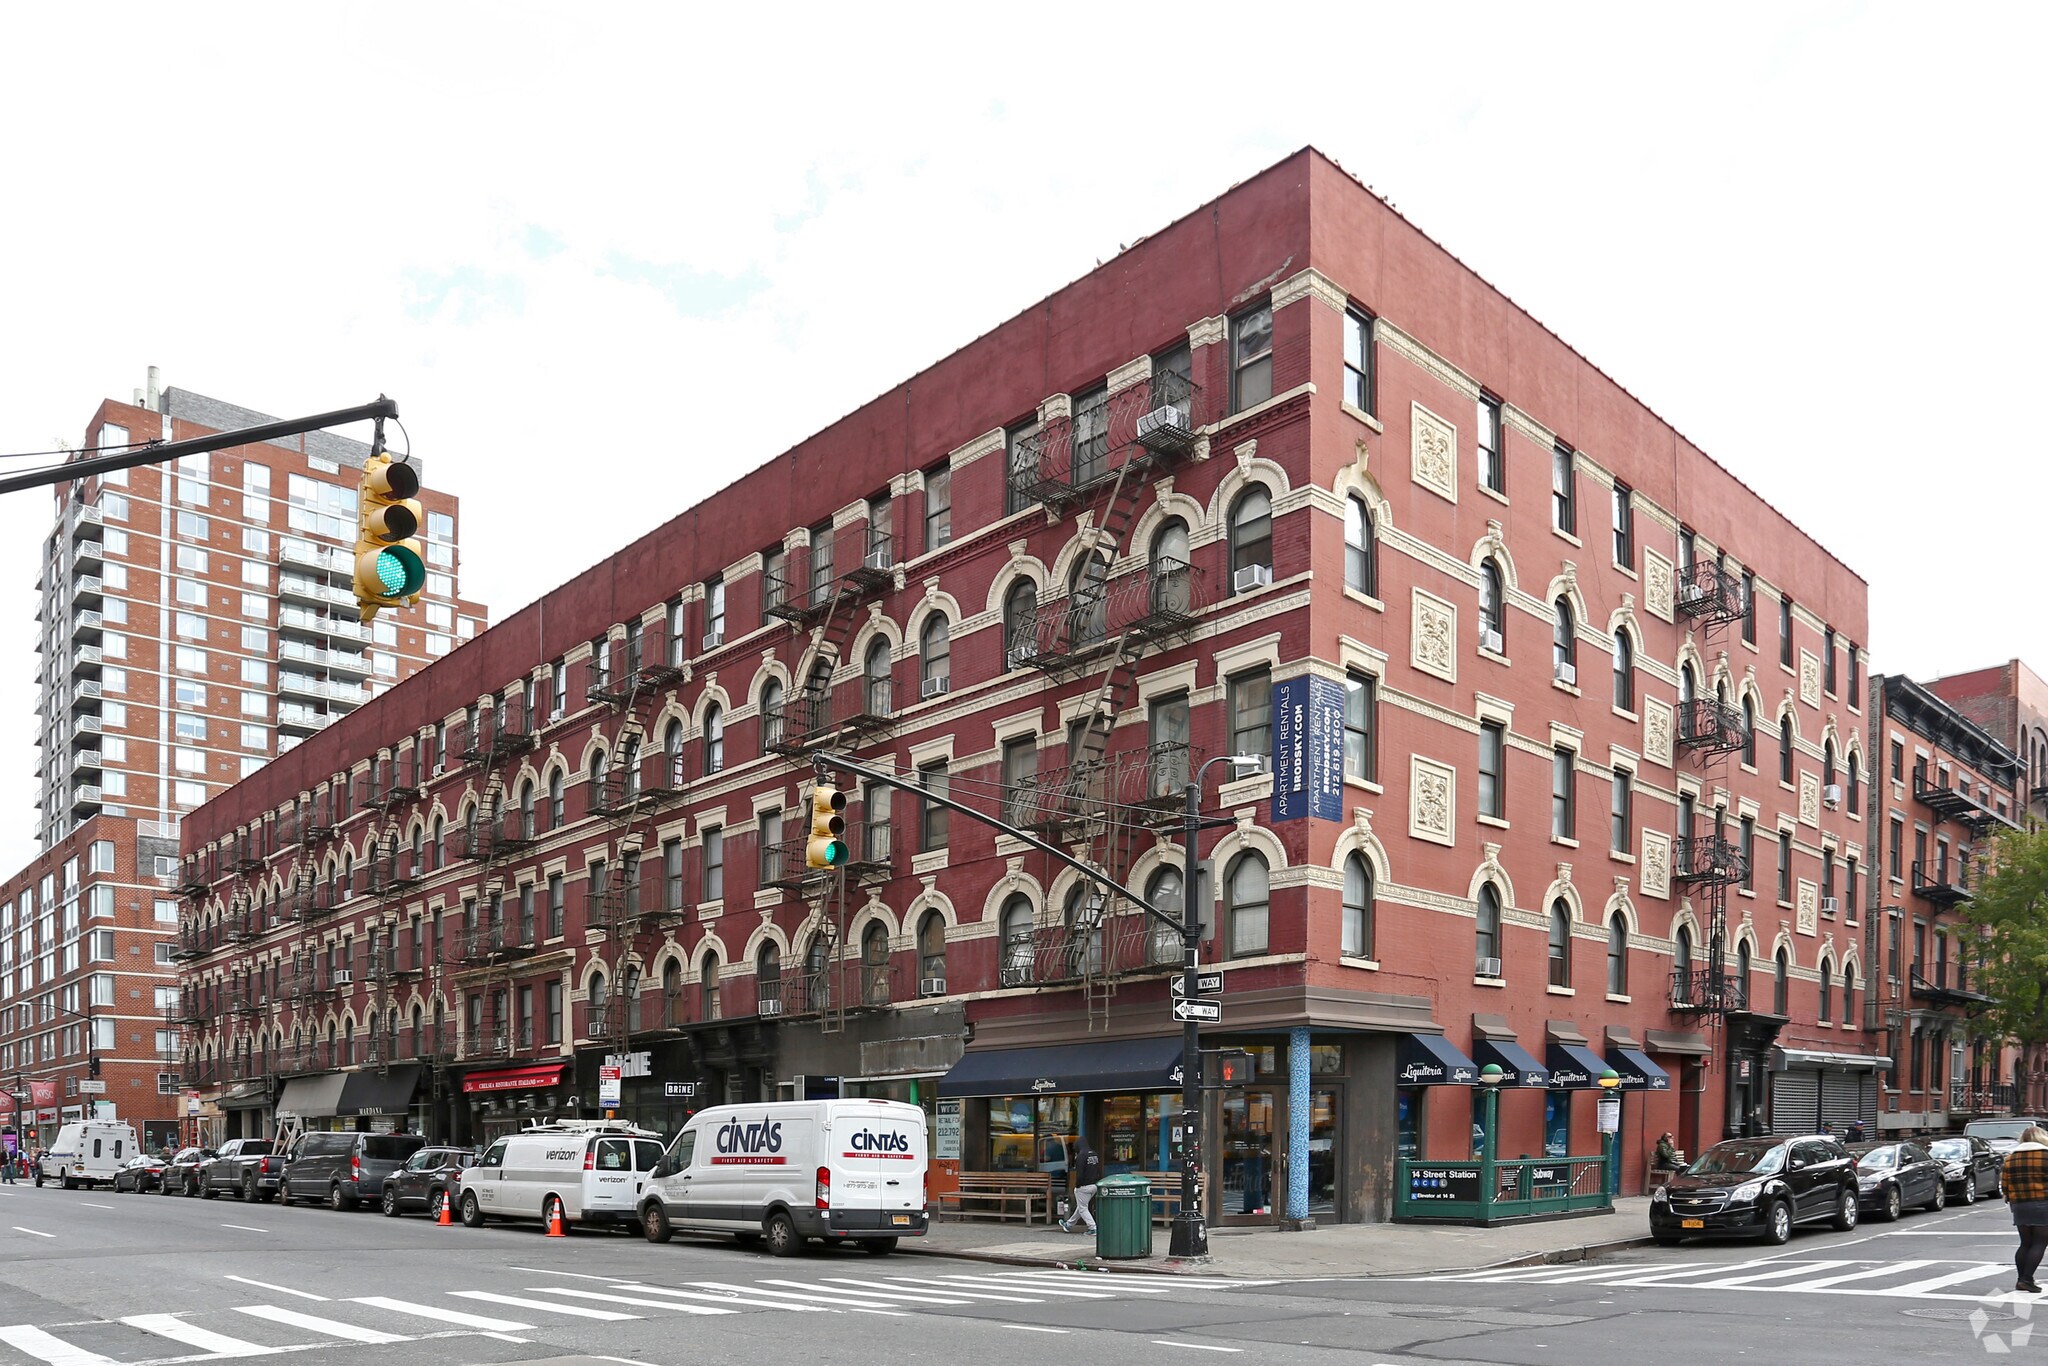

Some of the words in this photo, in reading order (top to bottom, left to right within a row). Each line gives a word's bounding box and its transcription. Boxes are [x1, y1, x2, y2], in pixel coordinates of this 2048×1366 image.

[1280, 685, 1290, 741] RENTALS
[1314, 680, 1322, 736] RENTALS
[1293, 704, 1303, 792] BRODSKY.COM
[1323, 706, 1331, 794] BRODSKY.COM
[1332, 709, 1341, 797] 212.619.2600
[1280, 743, 1289, 816] APARTMENT
[1313, 742, 1321, 813] APARTMENT
[1200, 978, 1218, 988] WAY
[1180, 1005, 1195, 1015] ONE
[1201, 1007, 1217, 1016] WAY
[1400, 1064, 1442, 1082] Liquiteria
[1548, 1070, 1588, 1087] Liquiteria
[545, 1148, 576, 1160] verizon
[1411, 1170, 1420, 1178] 14
[1423, 1170, 1447, 1178] Street
[1449, 1170, 1477, 1178] Station
[1533, 1168, 1554, 1180] Subway
